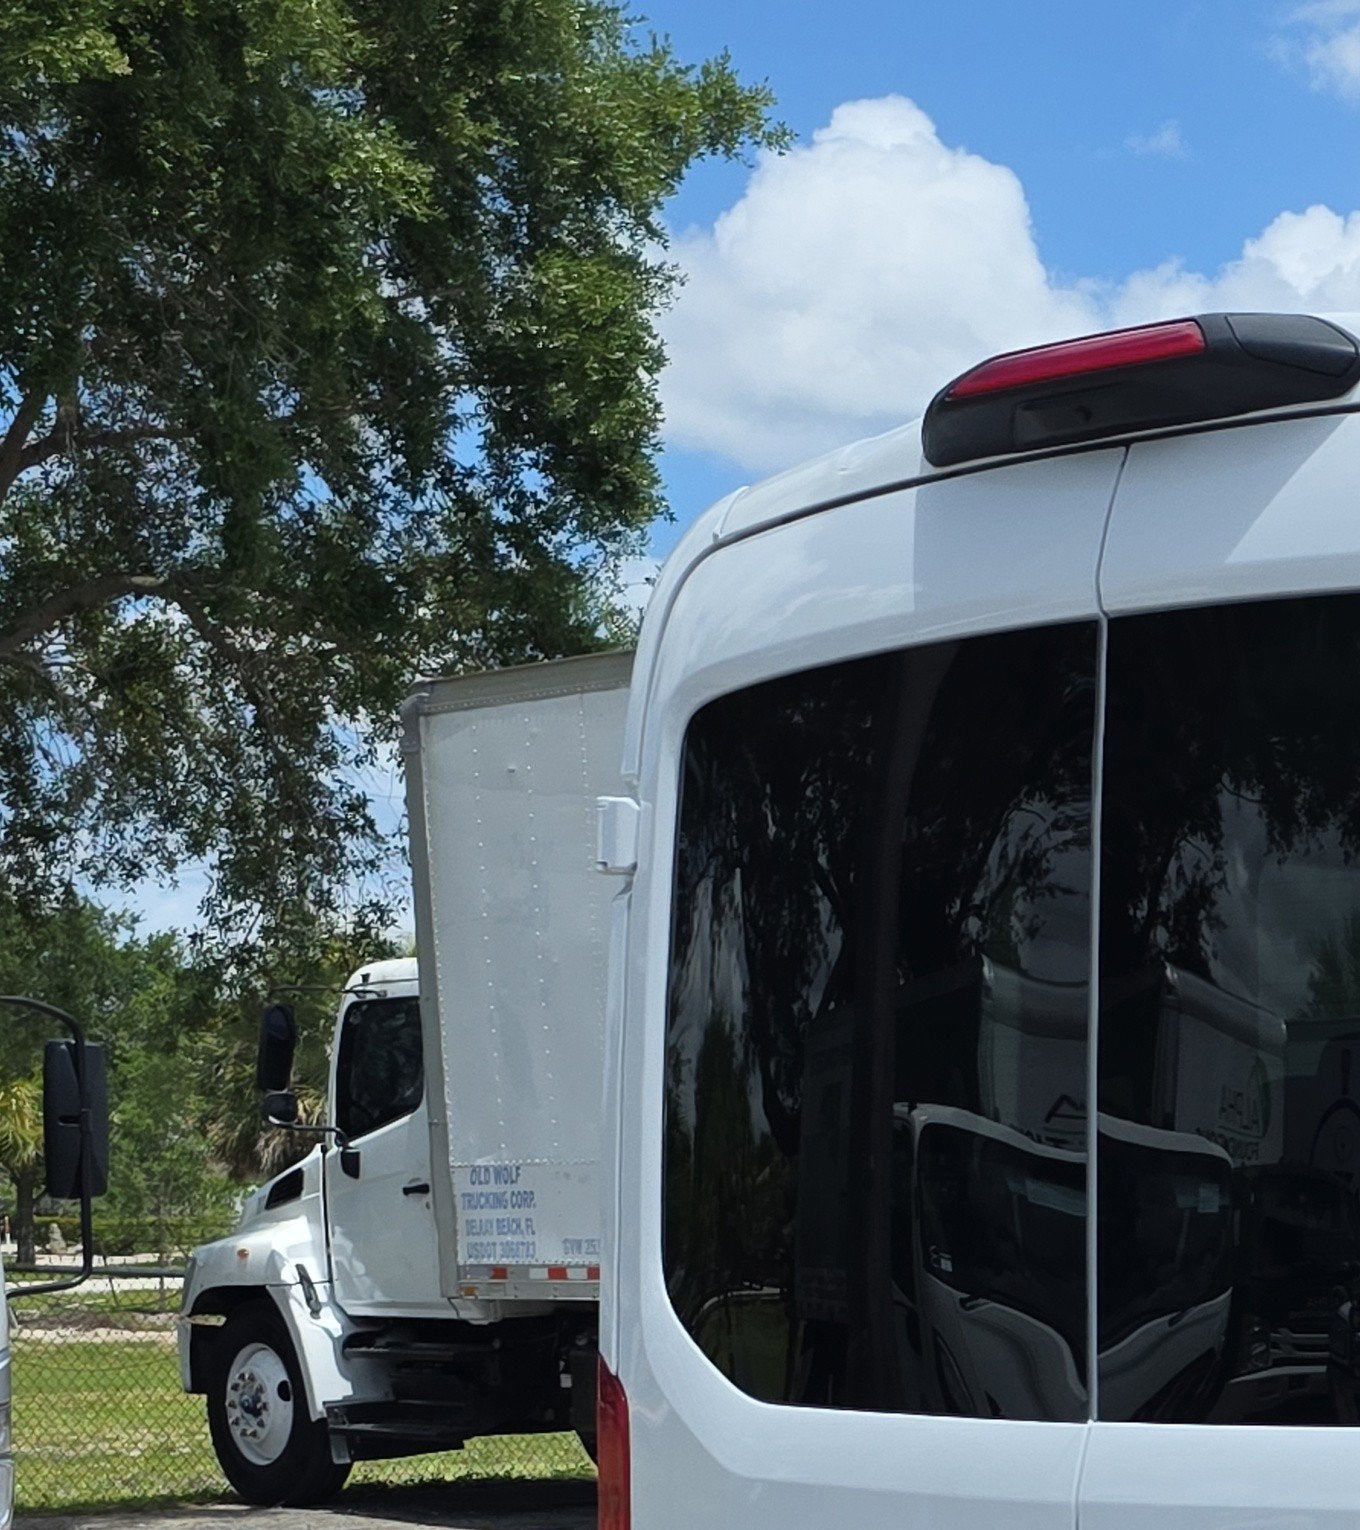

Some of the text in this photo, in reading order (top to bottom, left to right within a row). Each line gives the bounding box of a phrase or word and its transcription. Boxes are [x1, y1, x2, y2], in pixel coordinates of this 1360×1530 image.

[468, 1165, 521, 1186] OLD WOLF
[461, 1190, 537, 1210] TRUCKING CORP.
